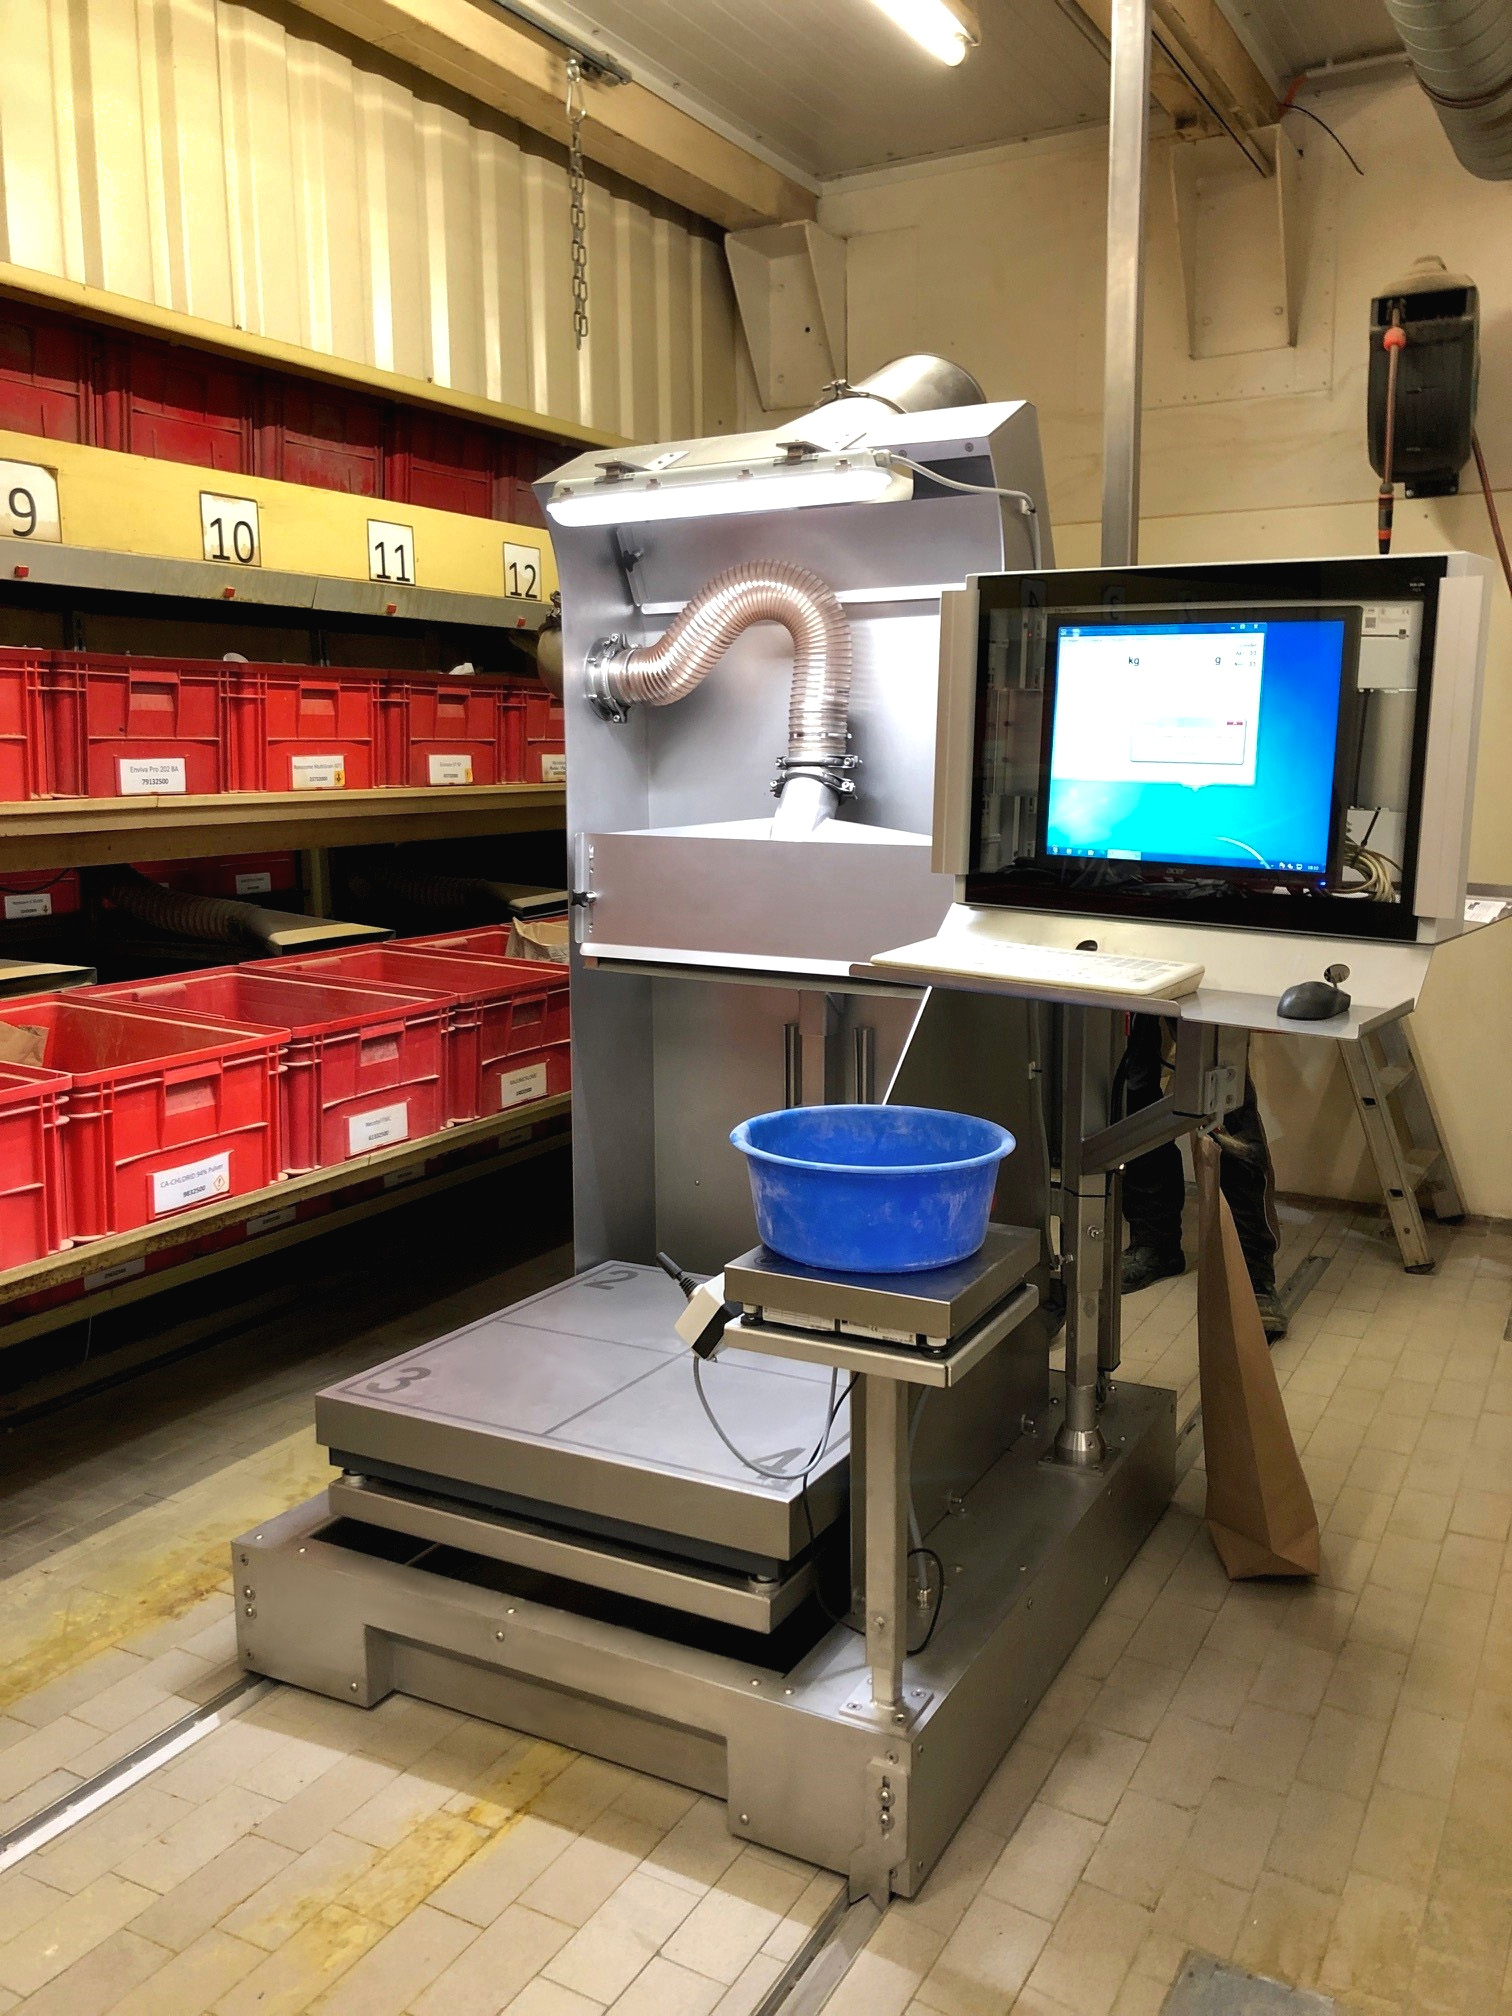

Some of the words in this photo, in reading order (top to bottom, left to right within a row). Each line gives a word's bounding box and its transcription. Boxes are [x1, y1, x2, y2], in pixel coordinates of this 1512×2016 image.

[9, 487, 37, 537] 9
[210, 517, 255, 564] 10
[375, 541, 411, 583] 11
[509, 561, 538, 599] 12
[1128, 656, 1140, 666] kg
[1215, 656, 1221, 666] g
[130, 766, 148, 774] Enviva
[160, 765, 170, 773] 202
[171, 765, 179, 773] BA
[142, 778, 169, 786] 79132500
[160, 1172, 196, 1188] CA-CHLORID
[583, 1269, 640, 1291] 2
[366, 1366, 431, 1394] 3
[743, 1446, 807, 1480] 4
